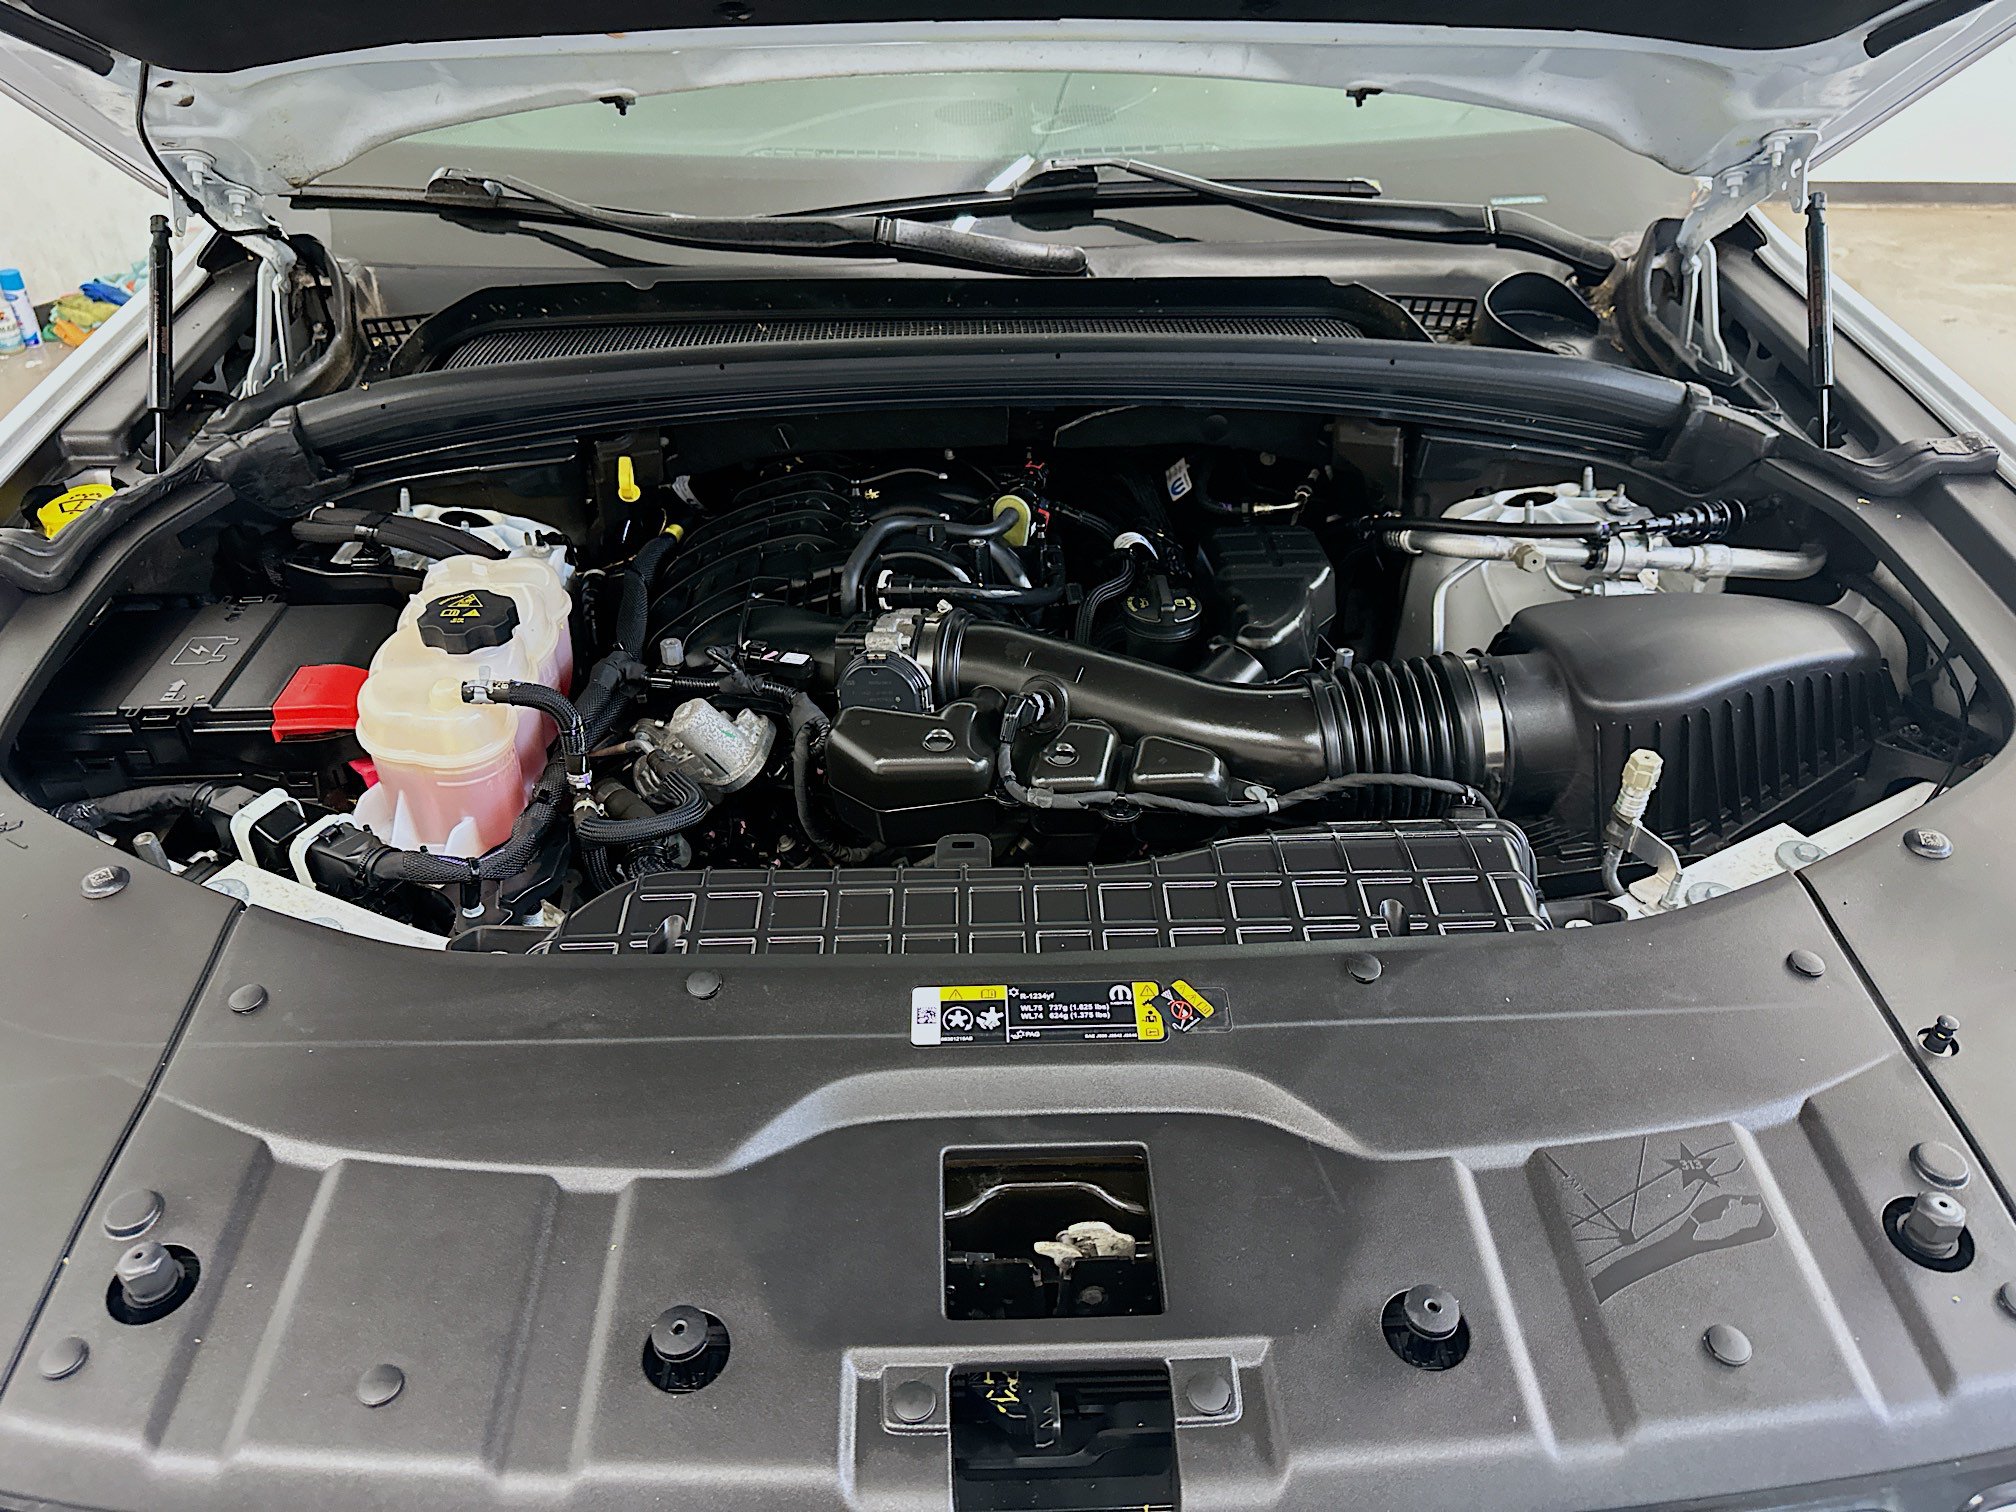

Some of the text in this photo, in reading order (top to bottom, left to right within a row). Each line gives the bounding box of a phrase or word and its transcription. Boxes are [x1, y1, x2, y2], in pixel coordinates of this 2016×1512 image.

[1020, 991, 1055, 1001] R-1234yf
[1020, 1004, 1043, 1012] WL75
[1049, 1004, 1068, 1012] 737g
[1095, 1003, 1110, 1012] lbs)
[1020, 1011, 1111, 1020] WL74 624g (1.375 lbs)
[1679, 1159, 1704, 1171] 313
